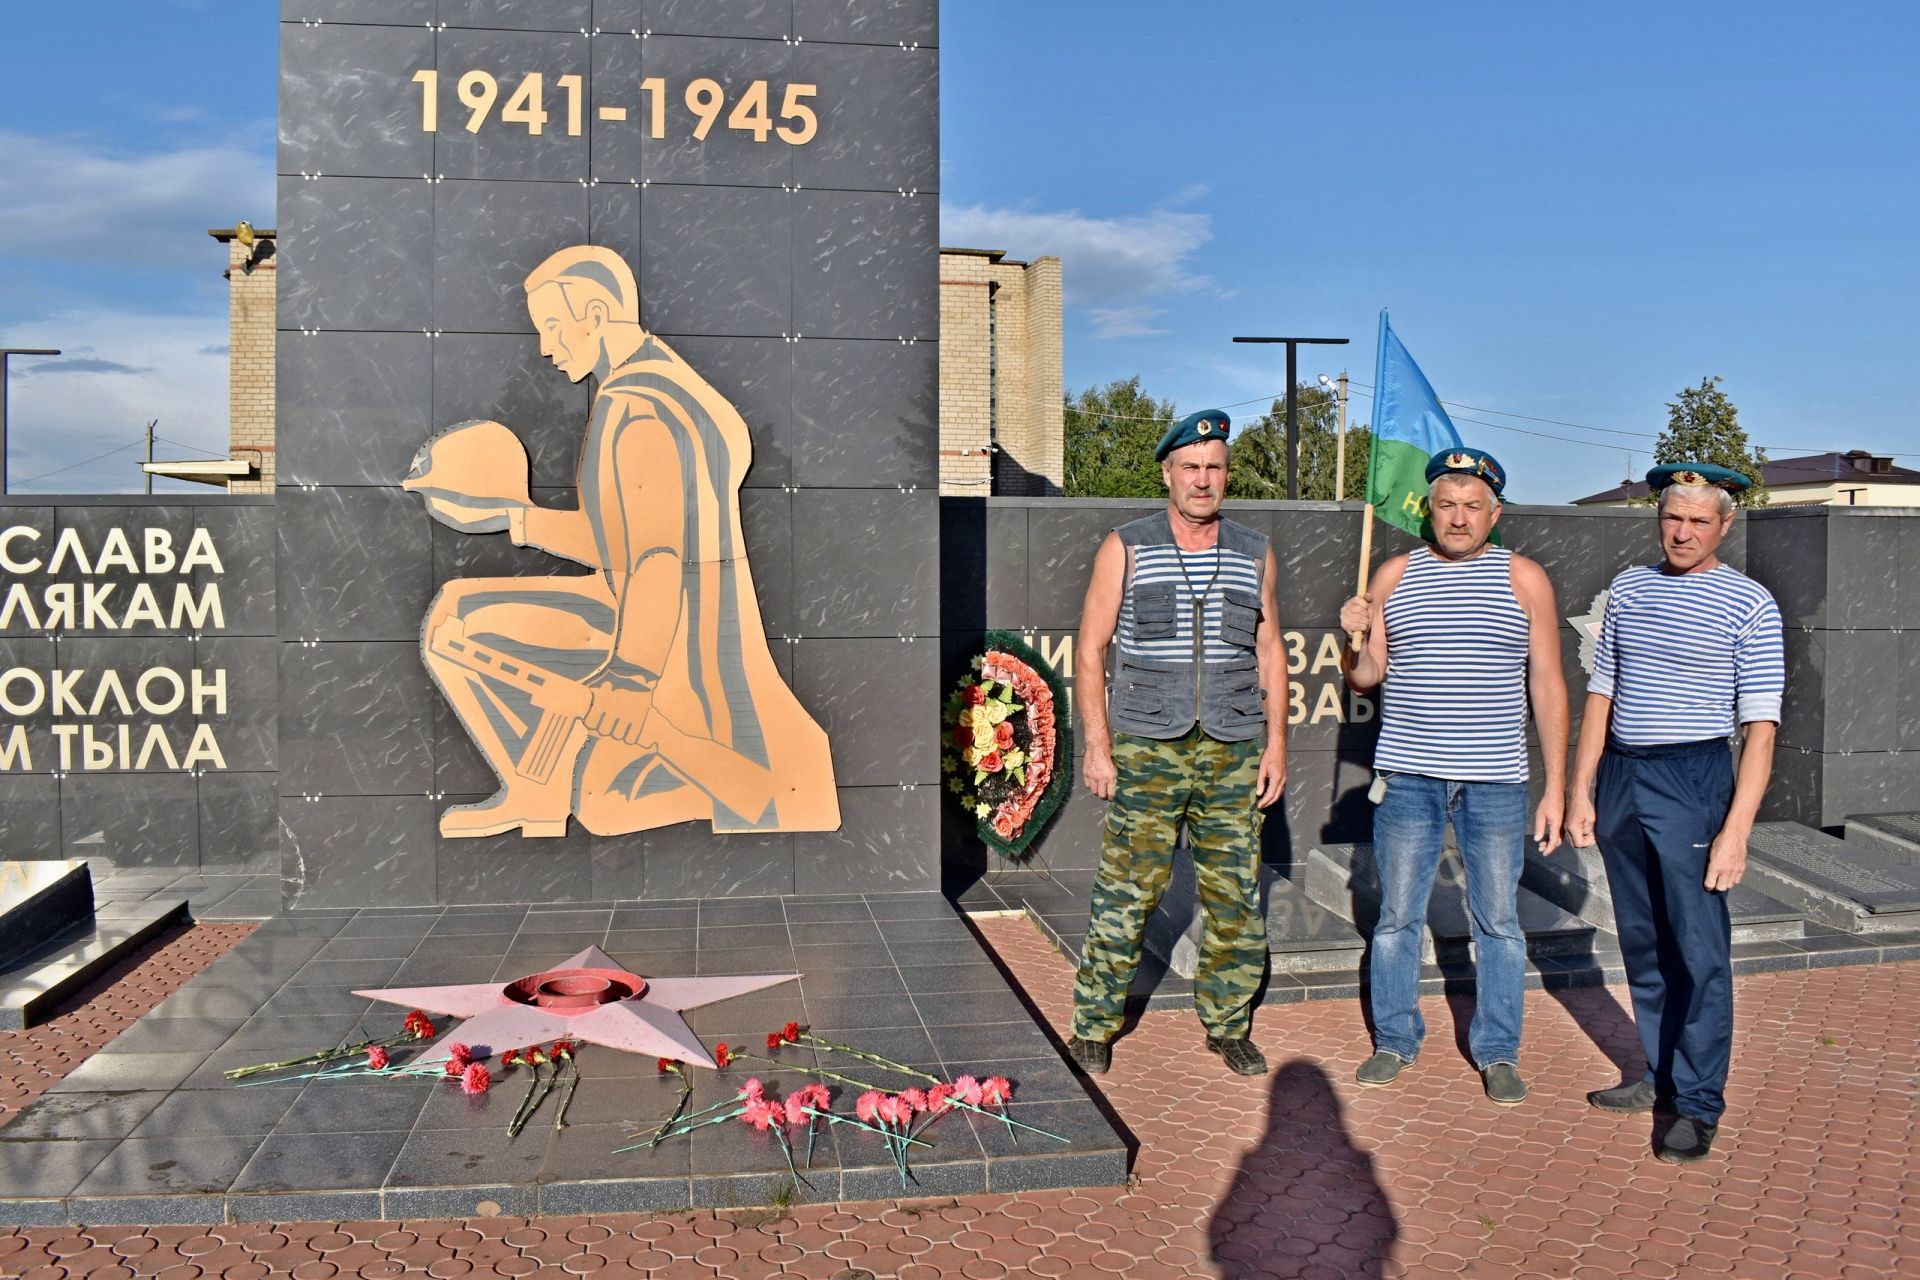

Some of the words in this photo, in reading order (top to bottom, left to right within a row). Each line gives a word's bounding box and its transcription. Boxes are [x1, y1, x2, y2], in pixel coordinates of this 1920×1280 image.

[0, 525, 224, 574] СЛАВА
[0, 583, 225, 629] ЛЯКАМ
[0, 667, 227, 716] ОКЛОН
[52, 724, 227, 770] ТЫЛА
